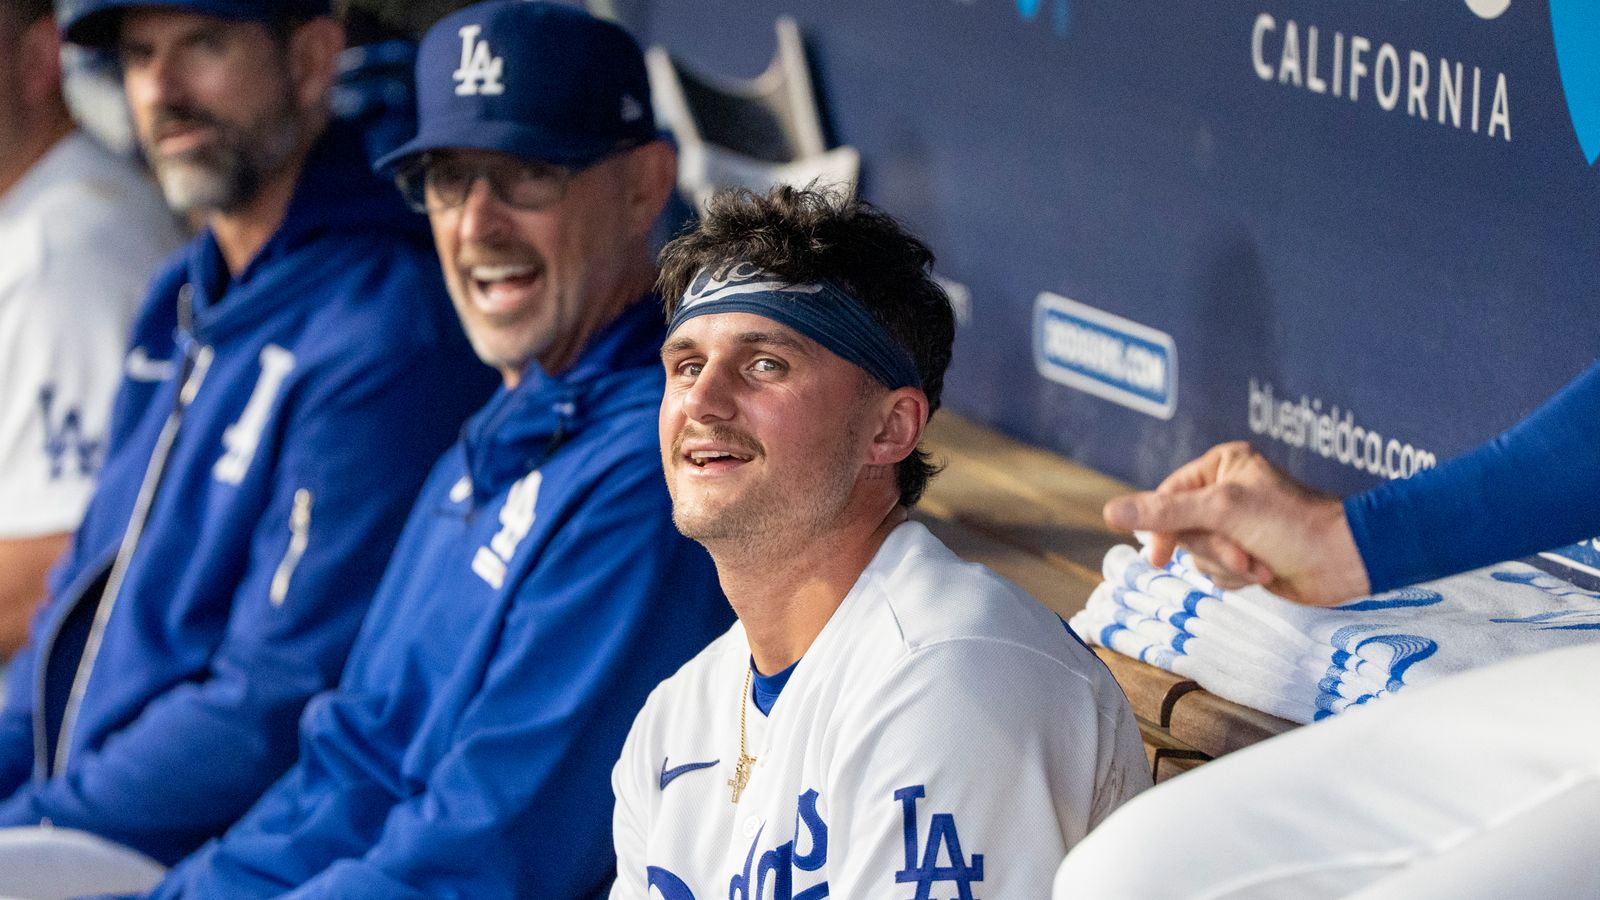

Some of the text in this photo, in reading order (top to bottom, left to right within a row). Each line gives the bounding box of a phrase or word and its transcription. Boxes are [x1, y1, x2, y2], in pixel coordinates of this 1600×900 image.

[452, 24, 504, 95] LA
[1252, 13, 1511, 142] CALIFORNIA
[893, 784, 984, 900] LA
